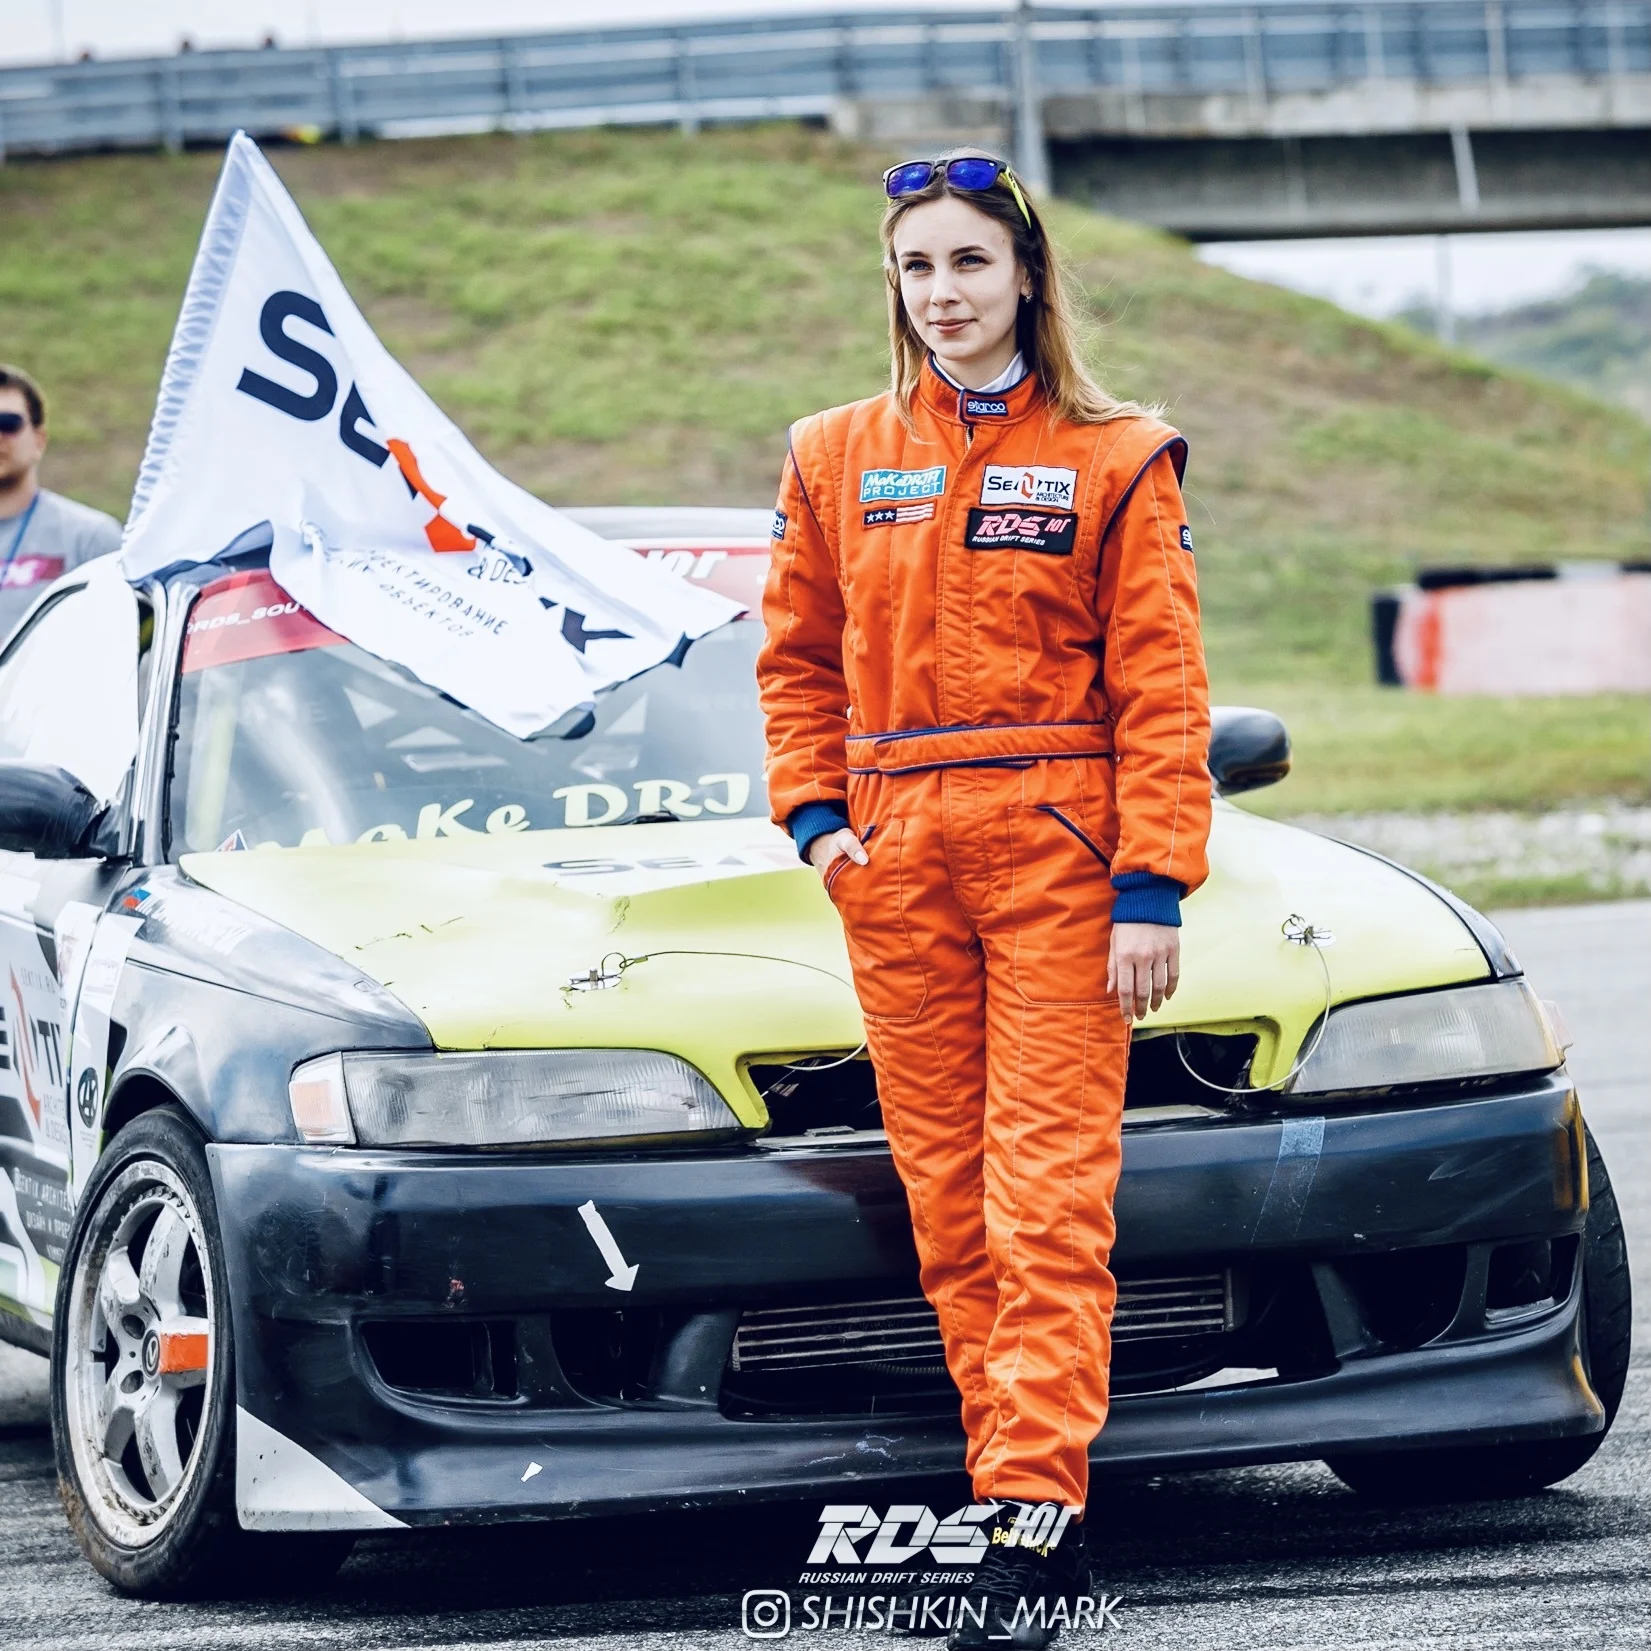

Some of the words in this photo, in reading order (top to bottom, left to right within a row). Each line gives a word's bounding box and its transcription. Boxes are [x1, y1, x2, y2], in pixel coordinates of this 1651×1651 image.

[967, 400, 1007, 414] sparco
[864, 482, 941, 498] PROJECT
[976, 514, 1047, 537] RDS
[972, 535, 999, 544] RUSSIAN
[999, 534, 1020, 543] DRIFT
[1020, 536, 1046, 546] SERIES
